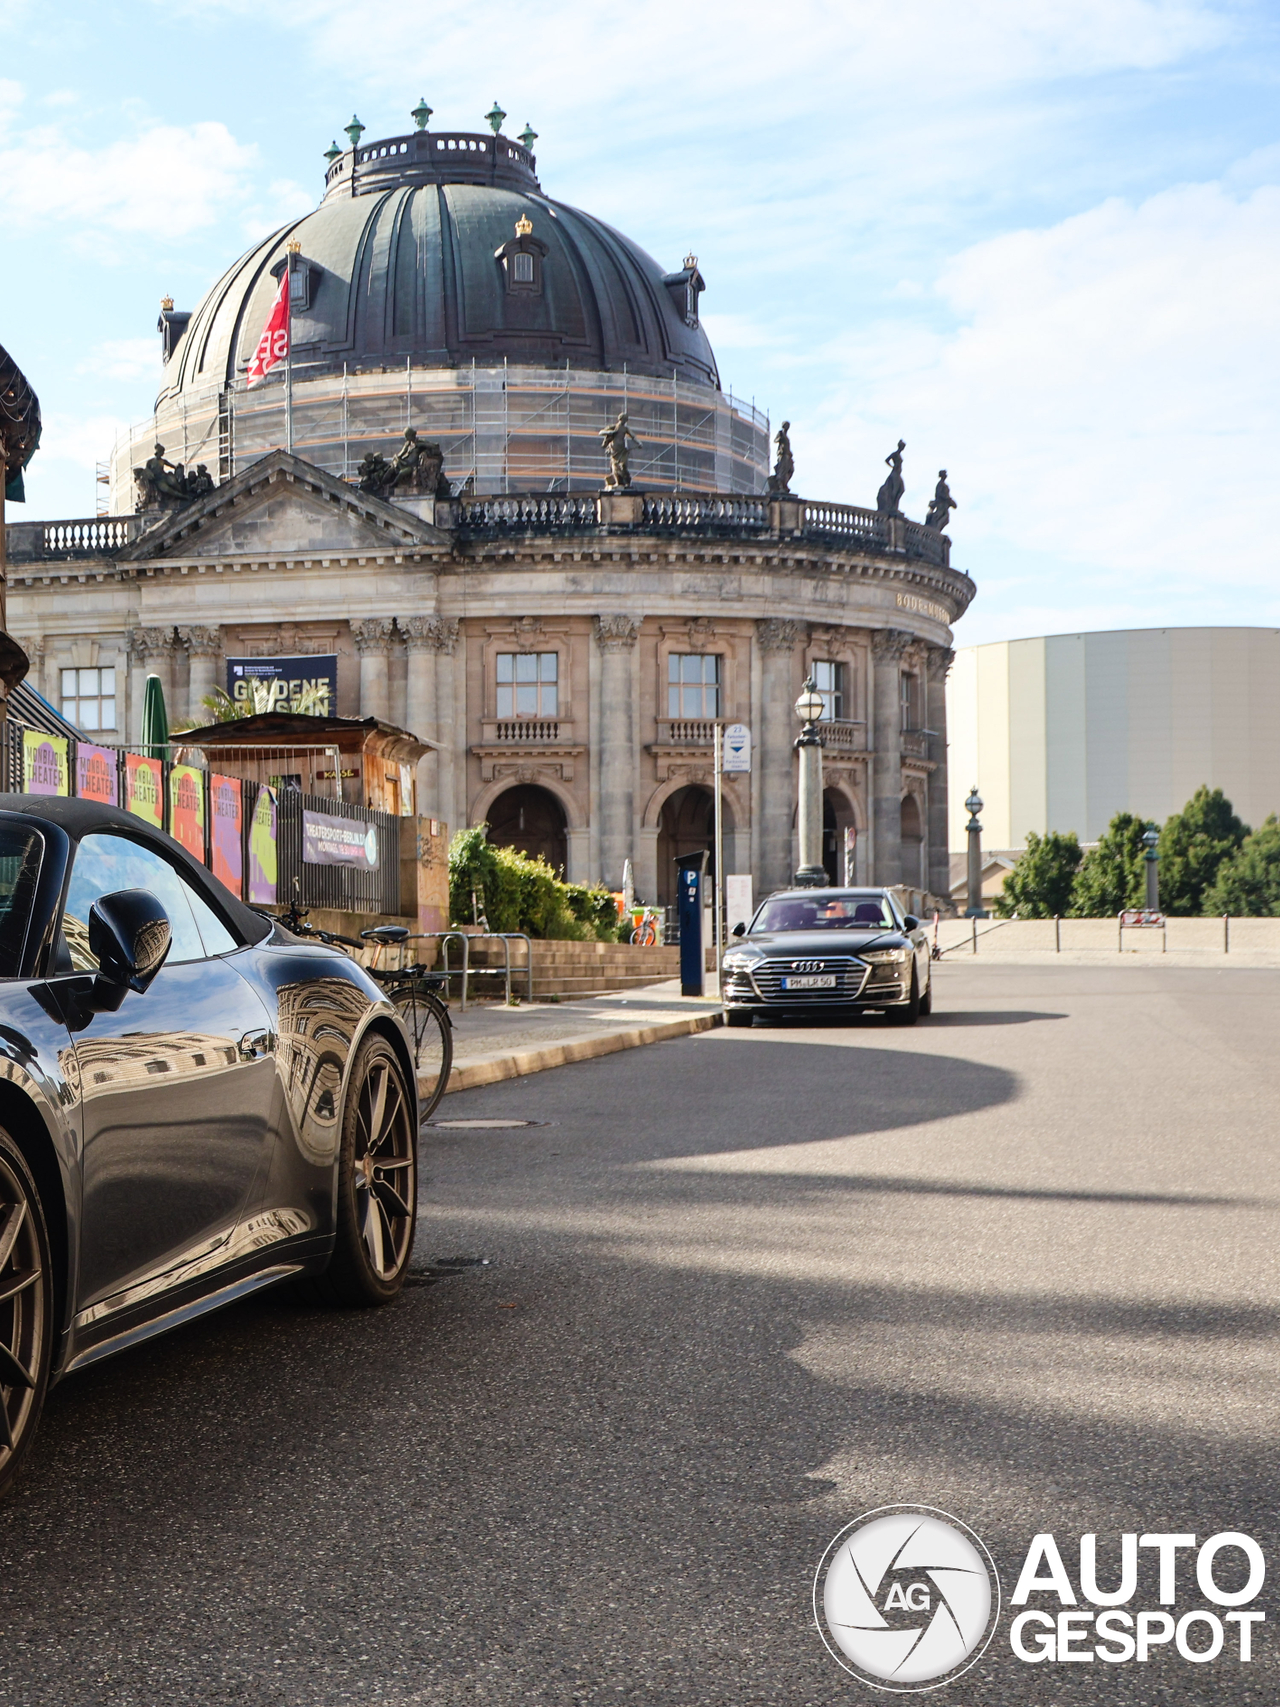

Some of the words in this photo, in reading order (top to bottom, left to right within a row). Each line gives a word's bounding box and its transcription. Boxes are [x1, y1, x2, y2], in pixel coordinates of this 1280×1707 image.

[233, 677, 330, 700] GDENE
[26, 745, 64, 768] MONBIJOU
[27, 763, 64, 787] THEATER
[324, 769, 354, 779] KASE
[80, 774, 115, 797] THEATER
[129, 783, 160, 805] THEATER
[173, 792, 201, 813] THEATER
[213, 800, 240, 820] THEATER
